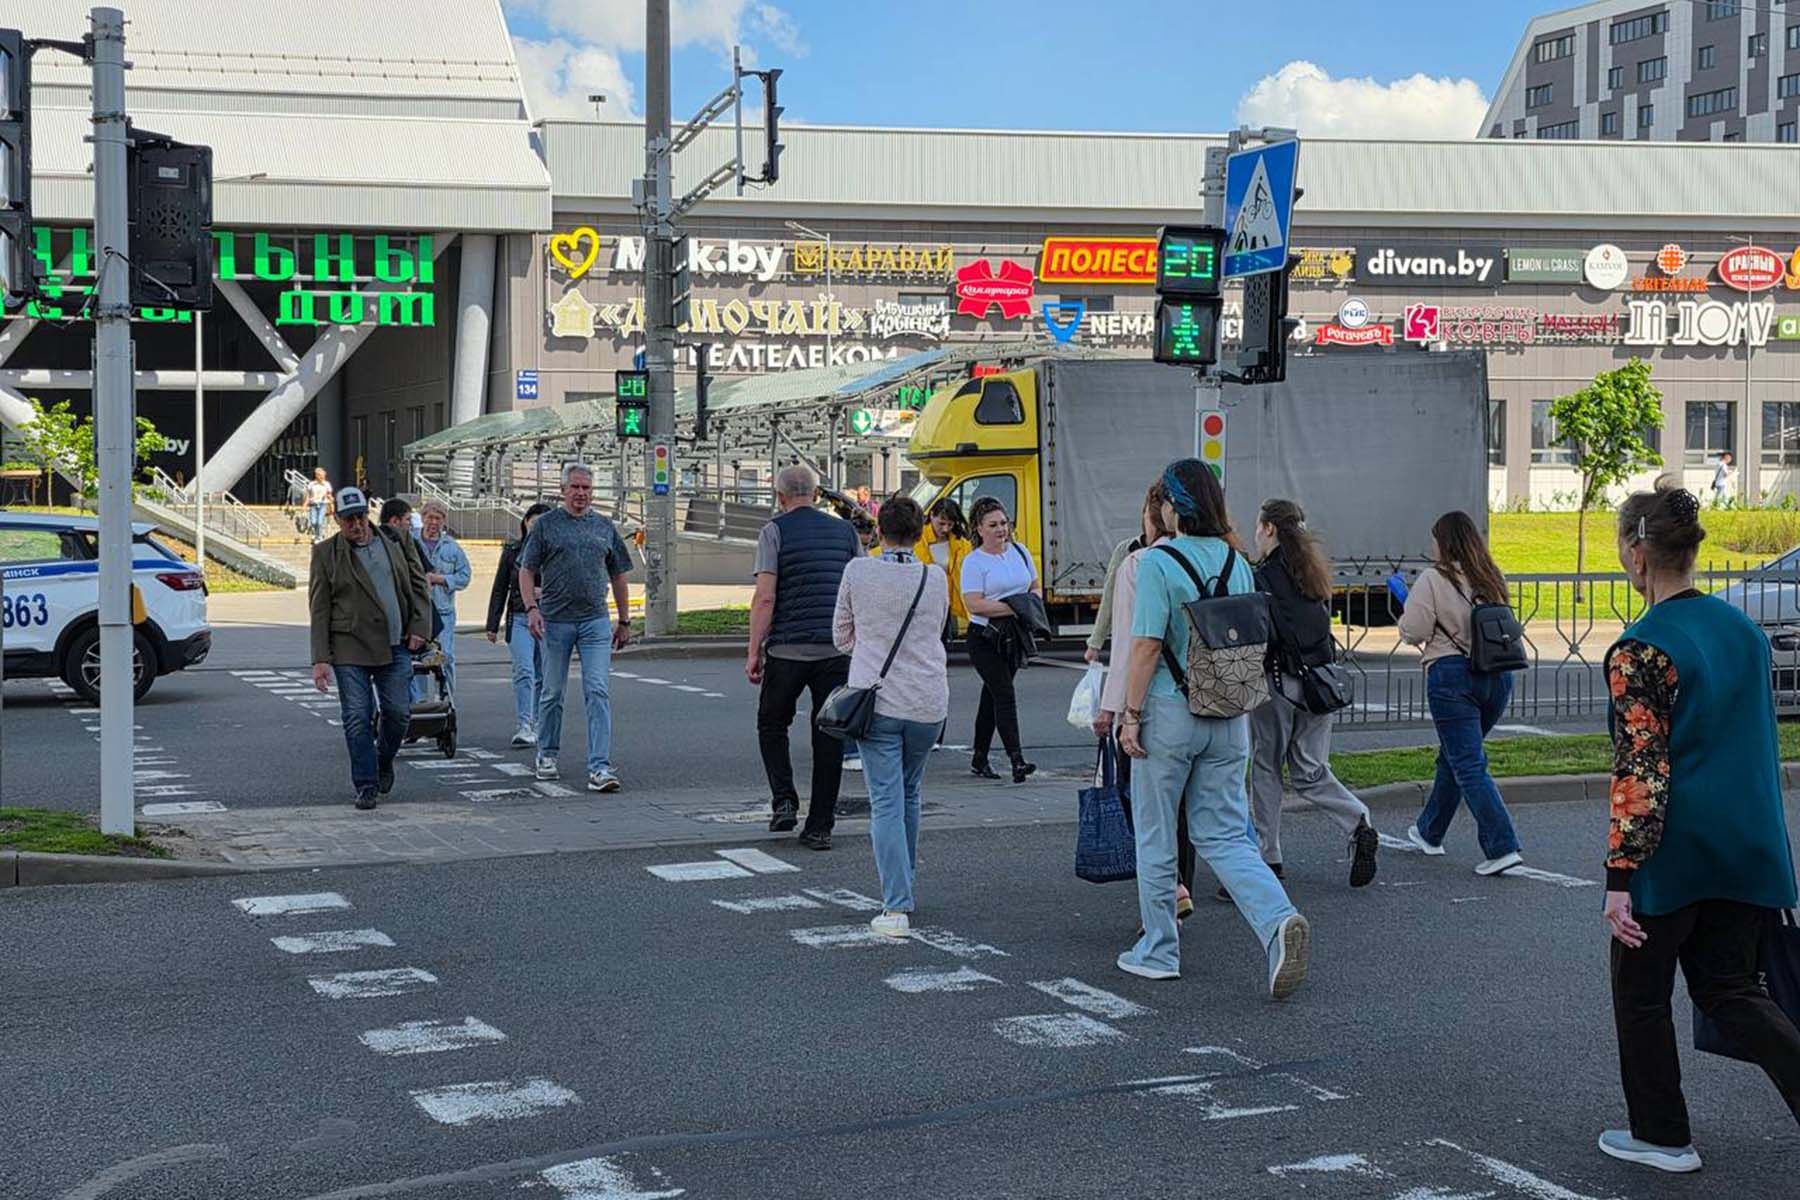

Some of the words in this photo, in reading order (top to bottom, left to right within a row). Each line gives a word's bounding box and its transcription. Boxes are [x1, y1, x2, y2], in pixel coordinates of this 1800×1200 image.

[829, 243, 954, 273] КАРАВАЙ
[1164, 245, 1214, 278] 20
[1367, 249, 1494, 281] divan.by
[1512, 258, 1542, 273] LEMON
[599, 292, 864, 339] «ДМОЧАЙ»
[870, 312, 951, 341] КРЫНКА
[1441, 320, 1537, 342] КОВРЫ
[518, 384, 537, 395] 134
[619, 379, 646, 396] 20
